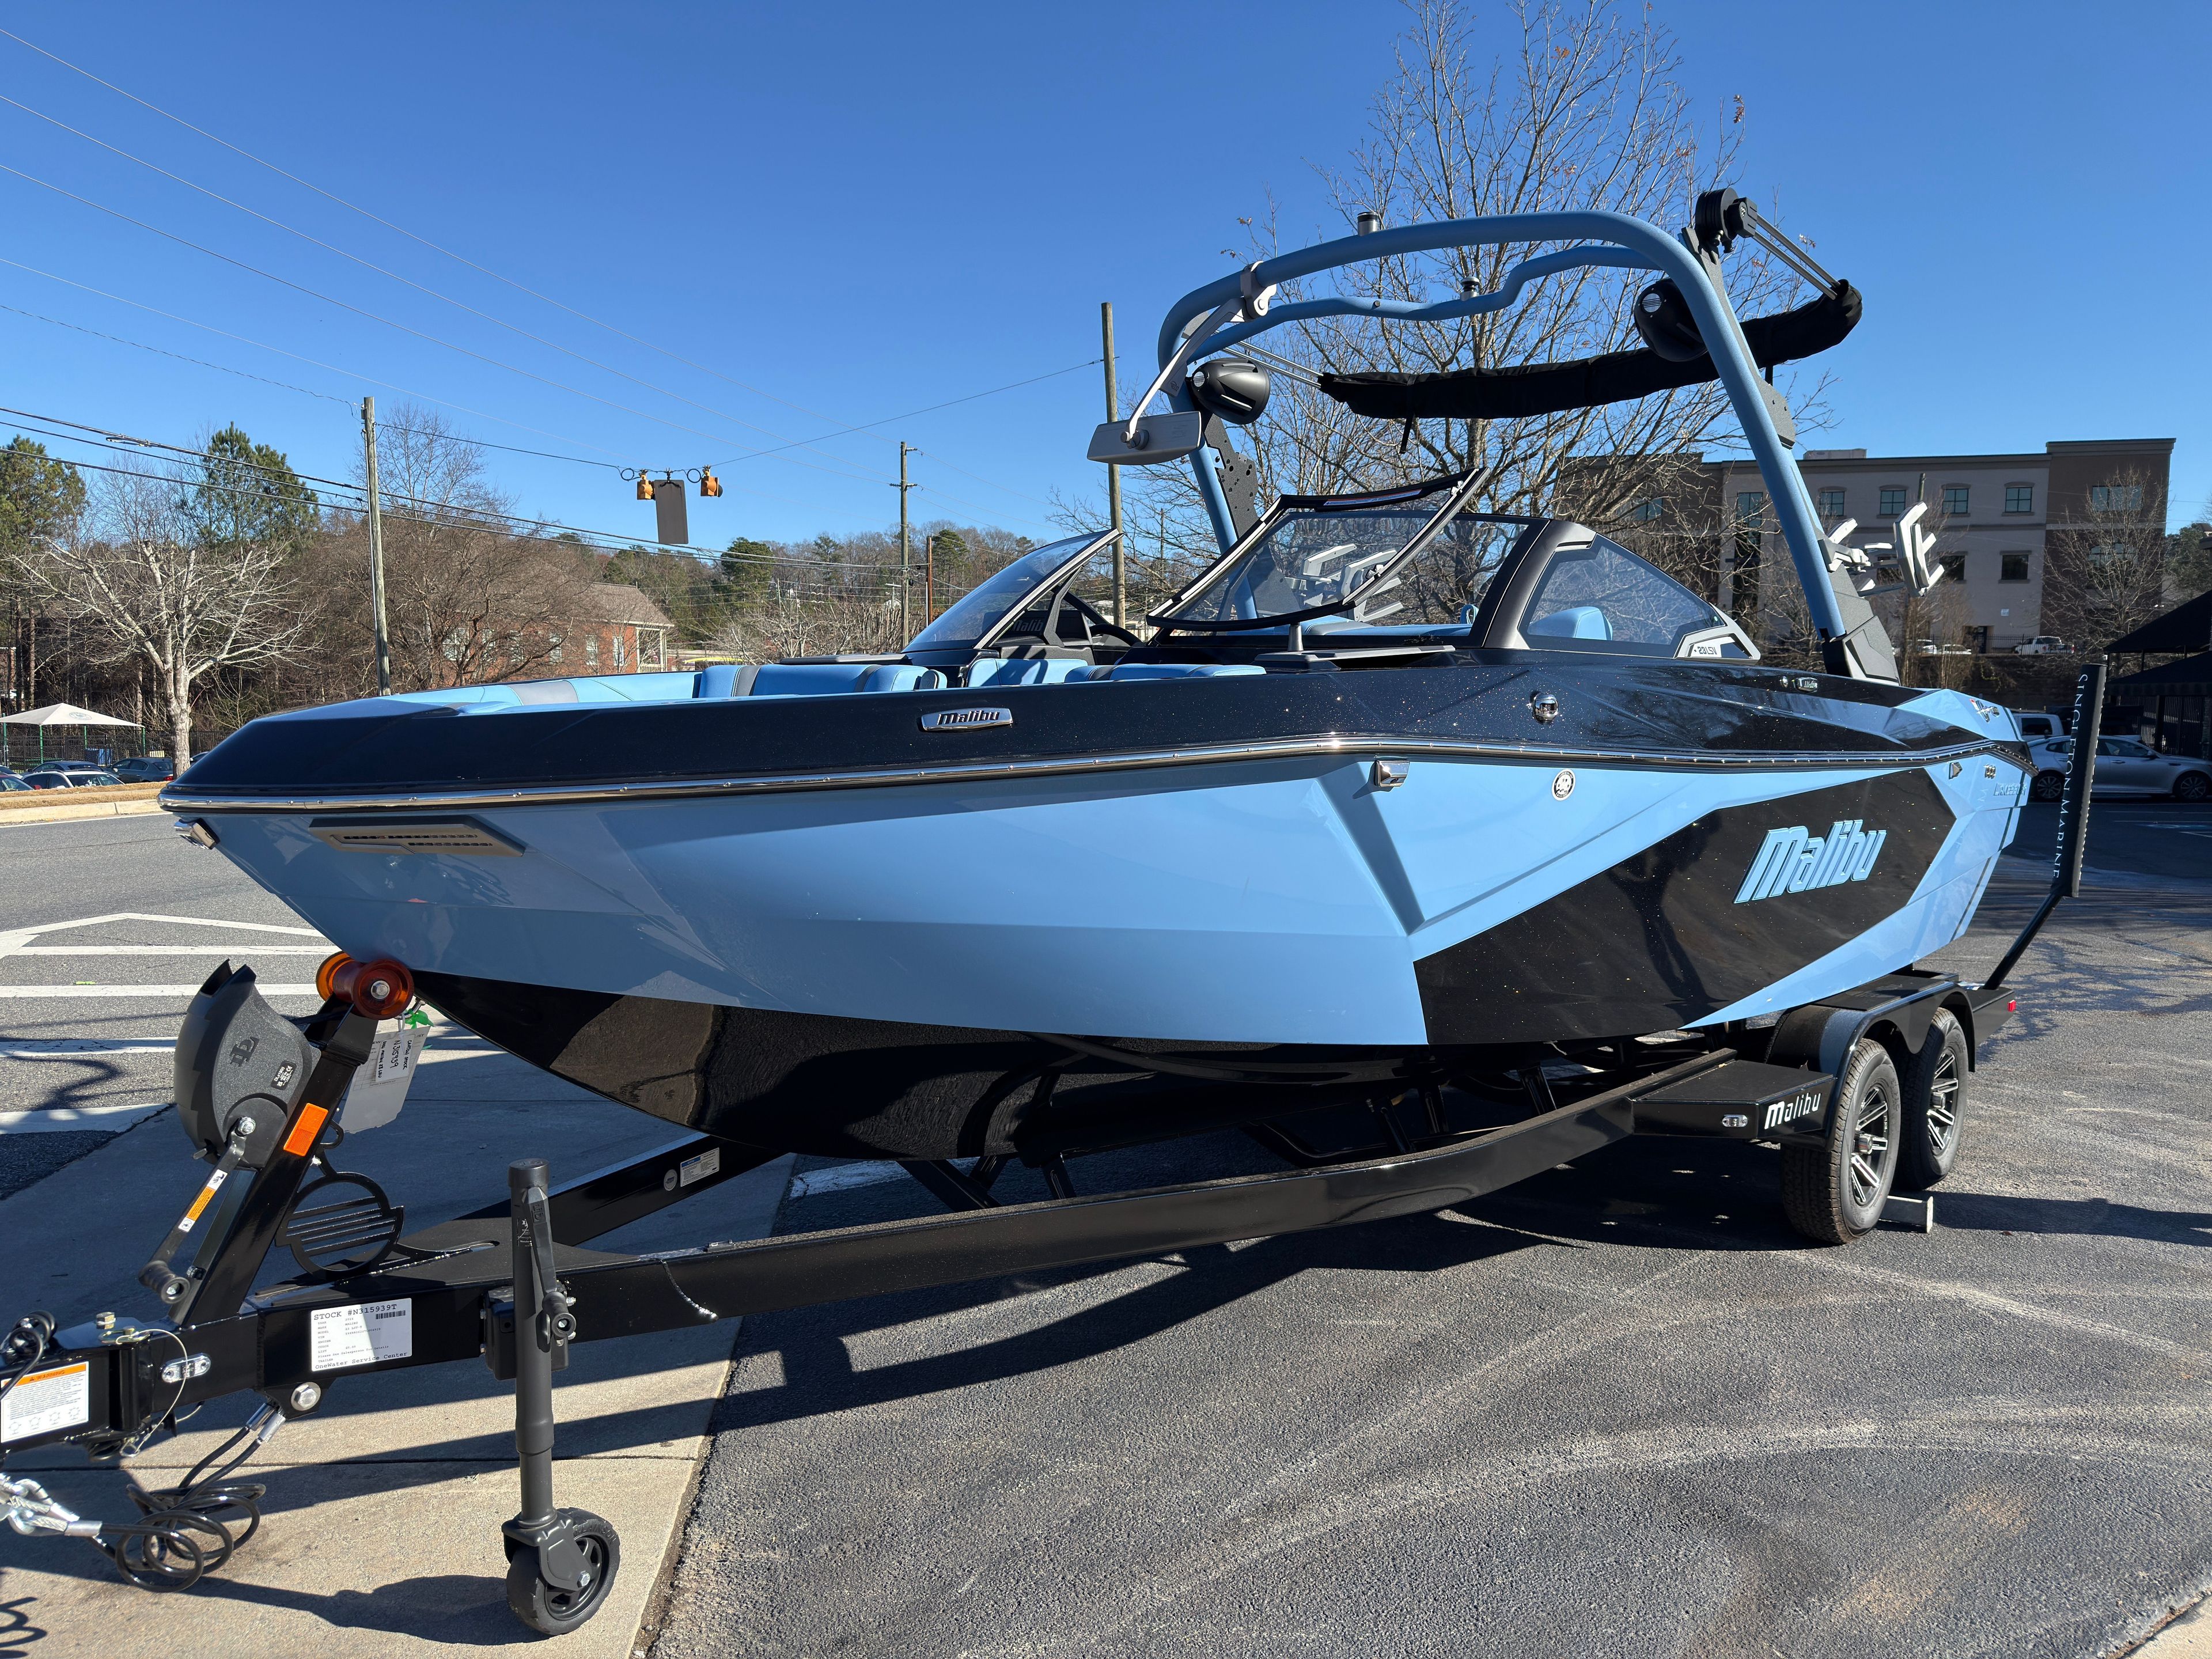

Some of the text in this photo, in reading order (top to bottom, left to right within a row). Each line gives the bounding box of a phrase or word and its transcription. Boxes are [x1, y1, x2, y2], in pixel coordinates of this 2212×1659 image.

[937, 710, 1000, 725] Malibu
[2053, 799, 2070, 878] MARINE
[1732, 819, 1887, 904] Malibu
[390, 1040, 401, 1069] N315939
[1764, 1092, 1821, 1130] Malibu
[314, 1304, 397, 1320] STOCK #N315939T
[315, 1351, 407, 1369] OneWater Service Center
